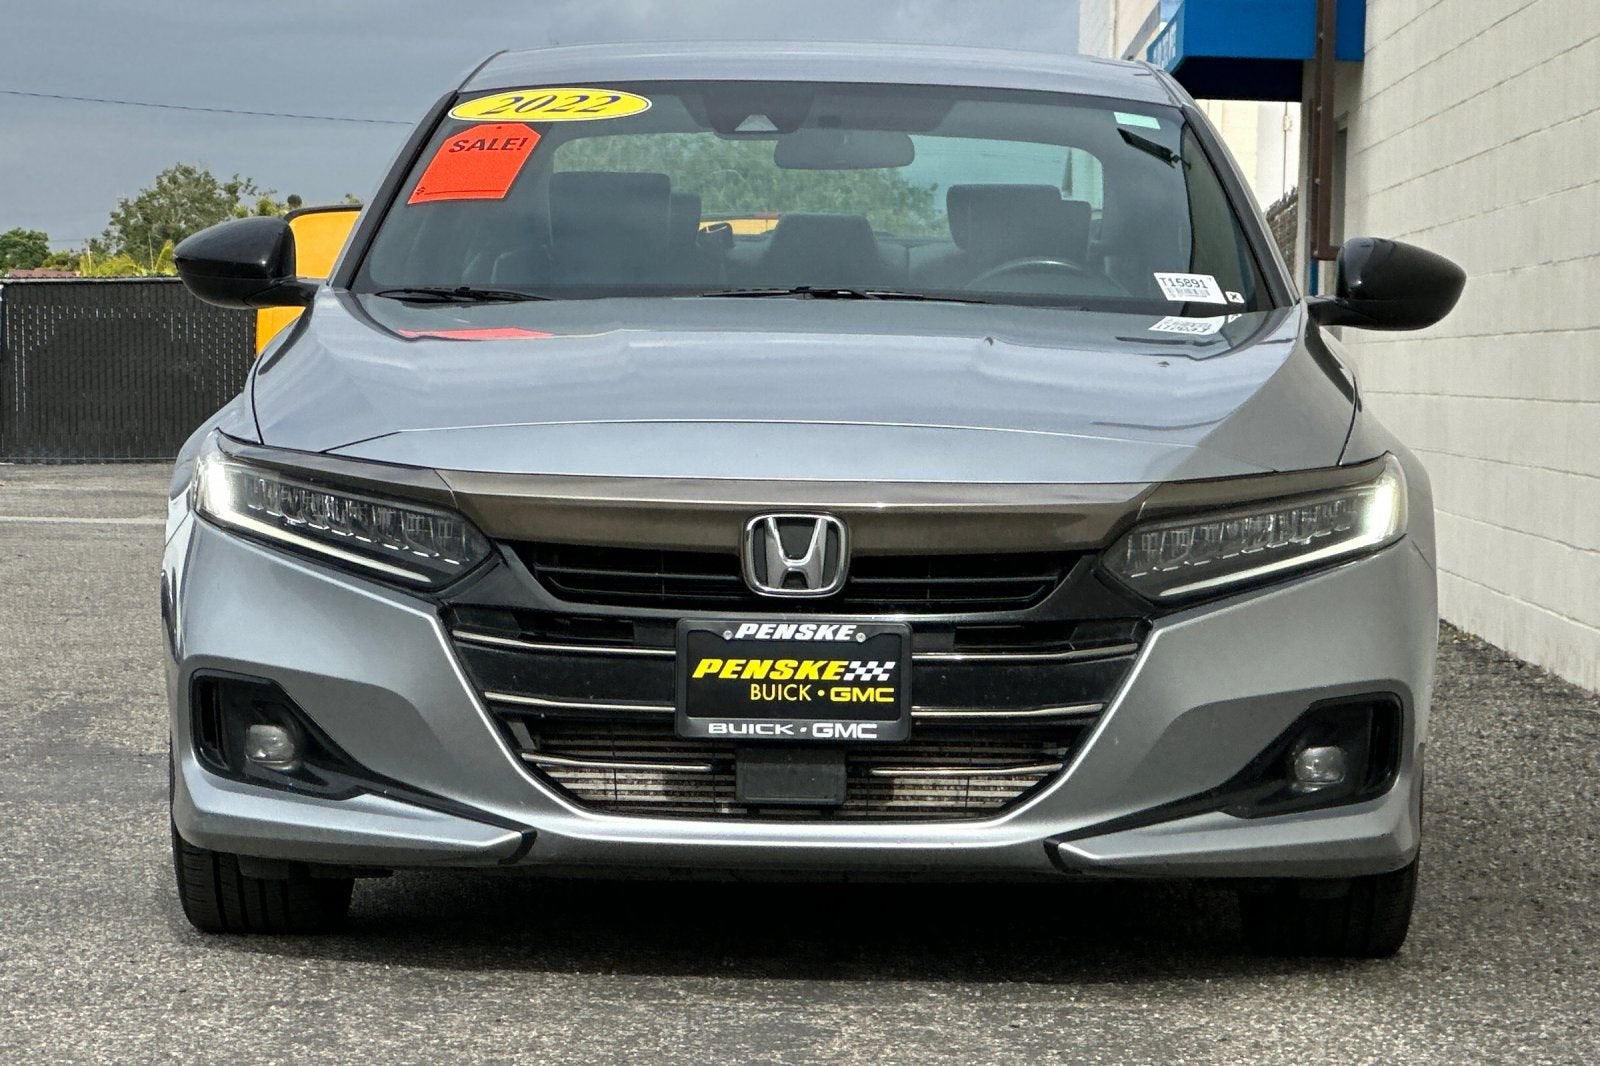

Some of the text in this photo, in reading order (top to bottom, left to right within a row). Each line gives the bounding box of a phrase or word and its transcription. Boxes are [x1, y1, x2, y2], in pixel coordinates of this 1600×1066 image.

[477, 94, 621, 116] 2022
[448, 137, 529, 153] SALE!
[1160, 277, 1209, 290] T15891
[734, 623, 857, 641] PENSKE
[692, 658, 851, 681] PENSKE
[750, 683, 895, 703] BUICK GMC
[708, 722, 878, 739] BUICK GMC
